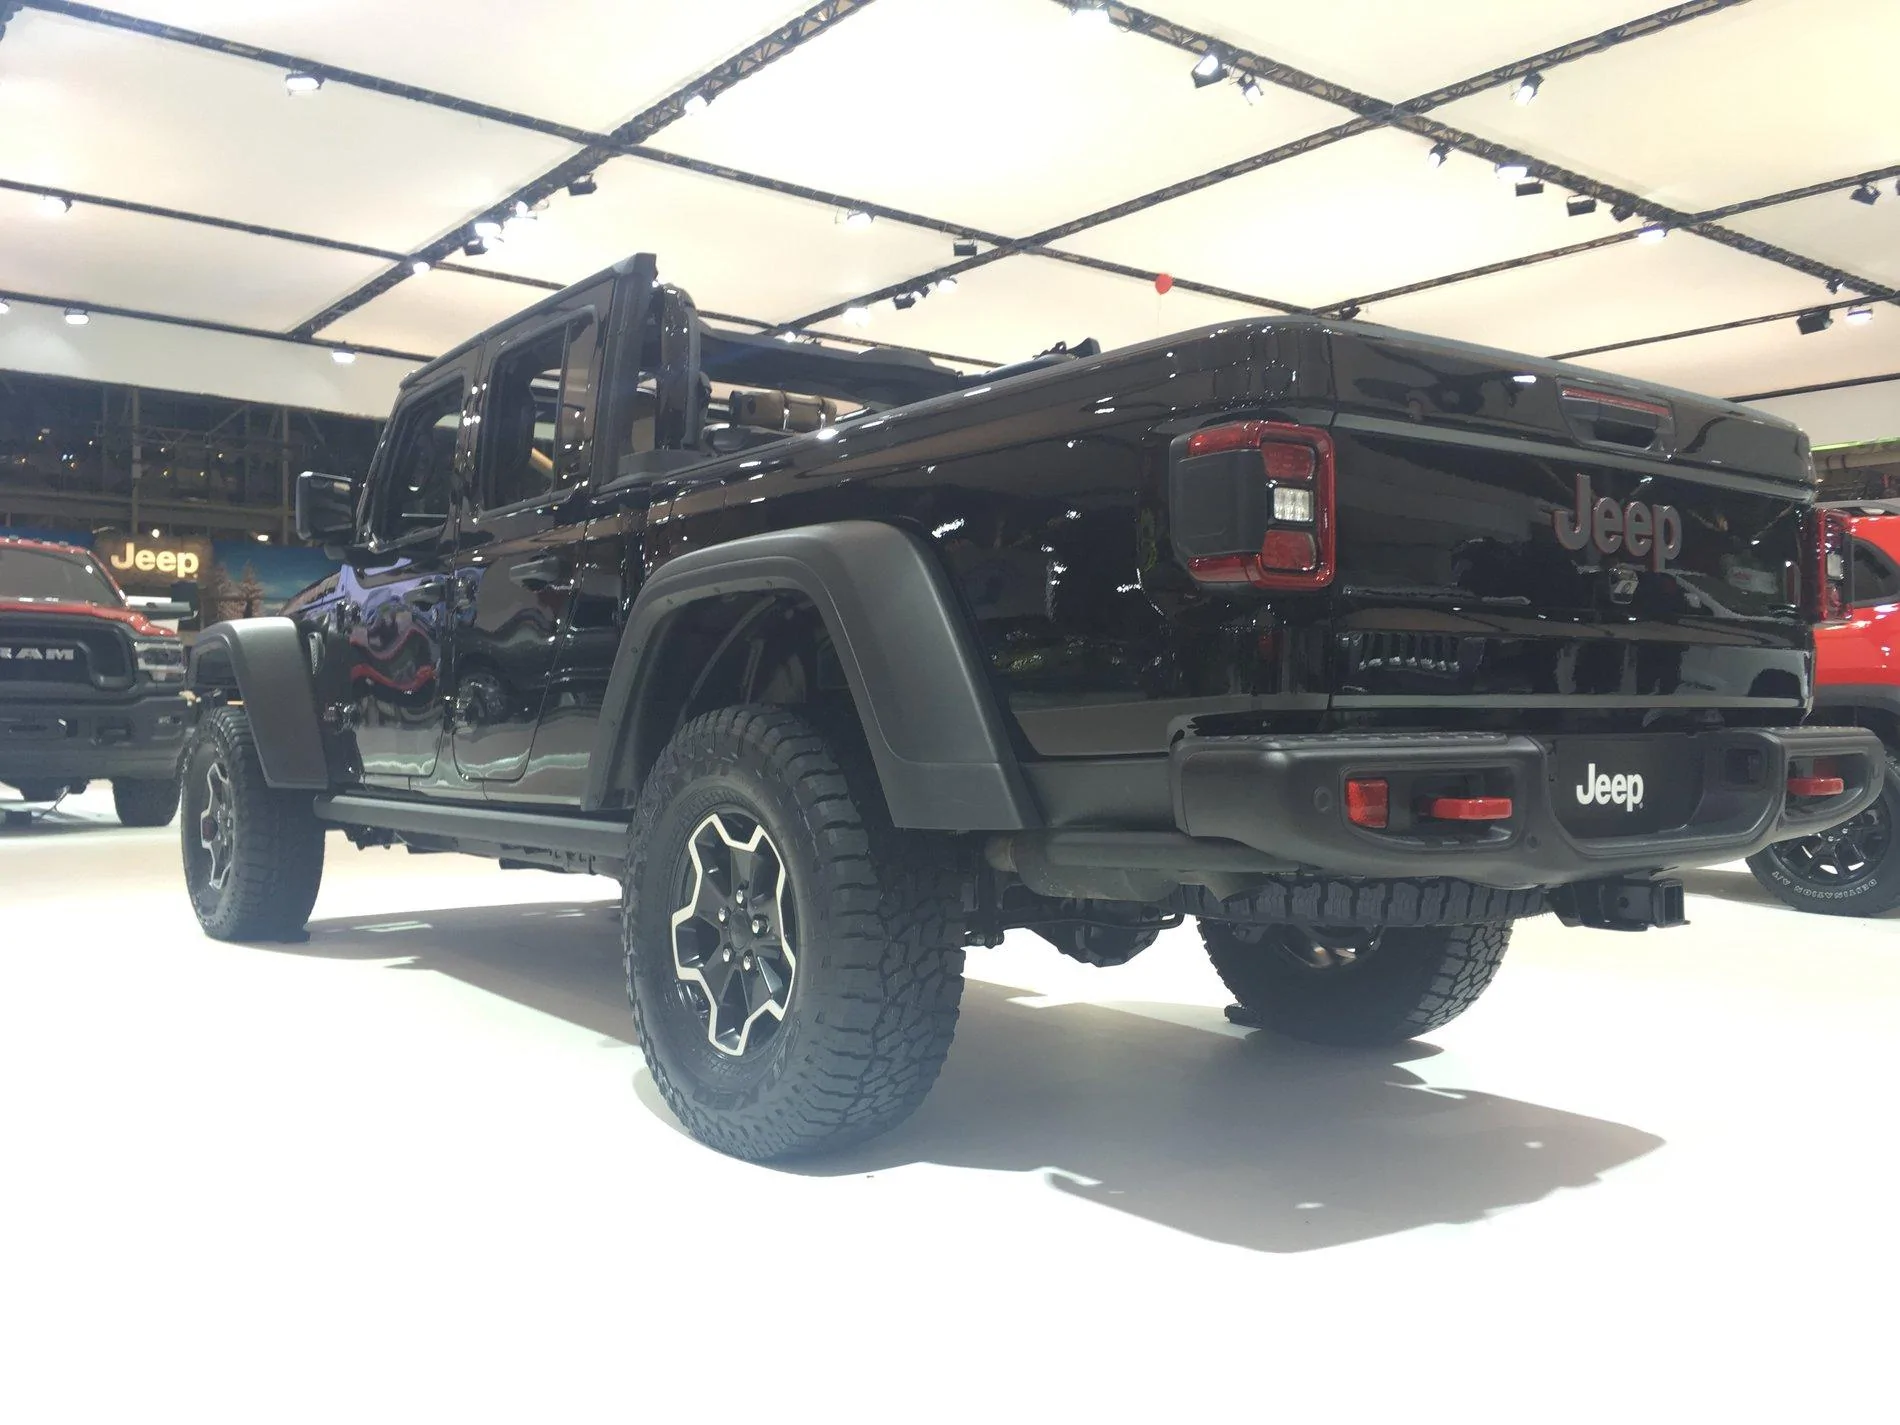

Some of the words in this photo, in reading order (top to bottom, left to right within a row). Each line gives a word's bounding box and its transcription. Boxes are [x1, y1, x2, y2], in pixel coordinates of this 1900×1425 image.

[1552, 472, 1682, 573] Jeep
[110, 542, 199, 578] Jeep
[1576, 763, 1644, 812] Jeep
[1793, 878, 1878, 899] DESTINATION
